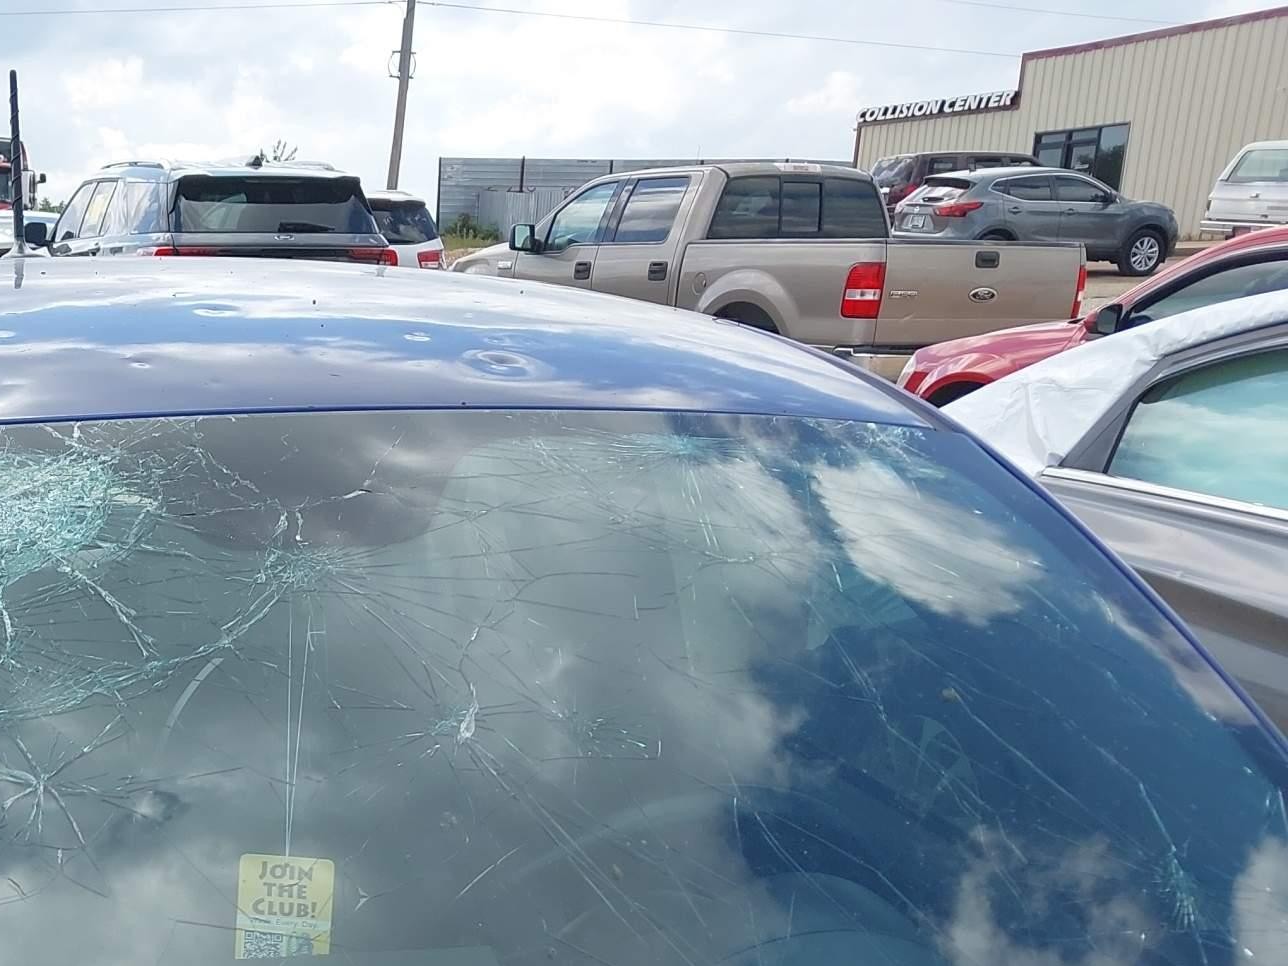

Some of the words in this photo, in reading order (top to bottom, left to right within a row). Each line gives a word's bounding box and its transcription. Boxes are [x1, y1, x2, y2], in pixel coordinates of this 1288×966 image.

[856, 101, 943, 122] COLLISION
[942, 90, 1016, 113] CENTER
[259, 861, 313, 881] JOIN
[263, 882, 307, 899] THE
[252, 898, 317, 918] CLUB!
